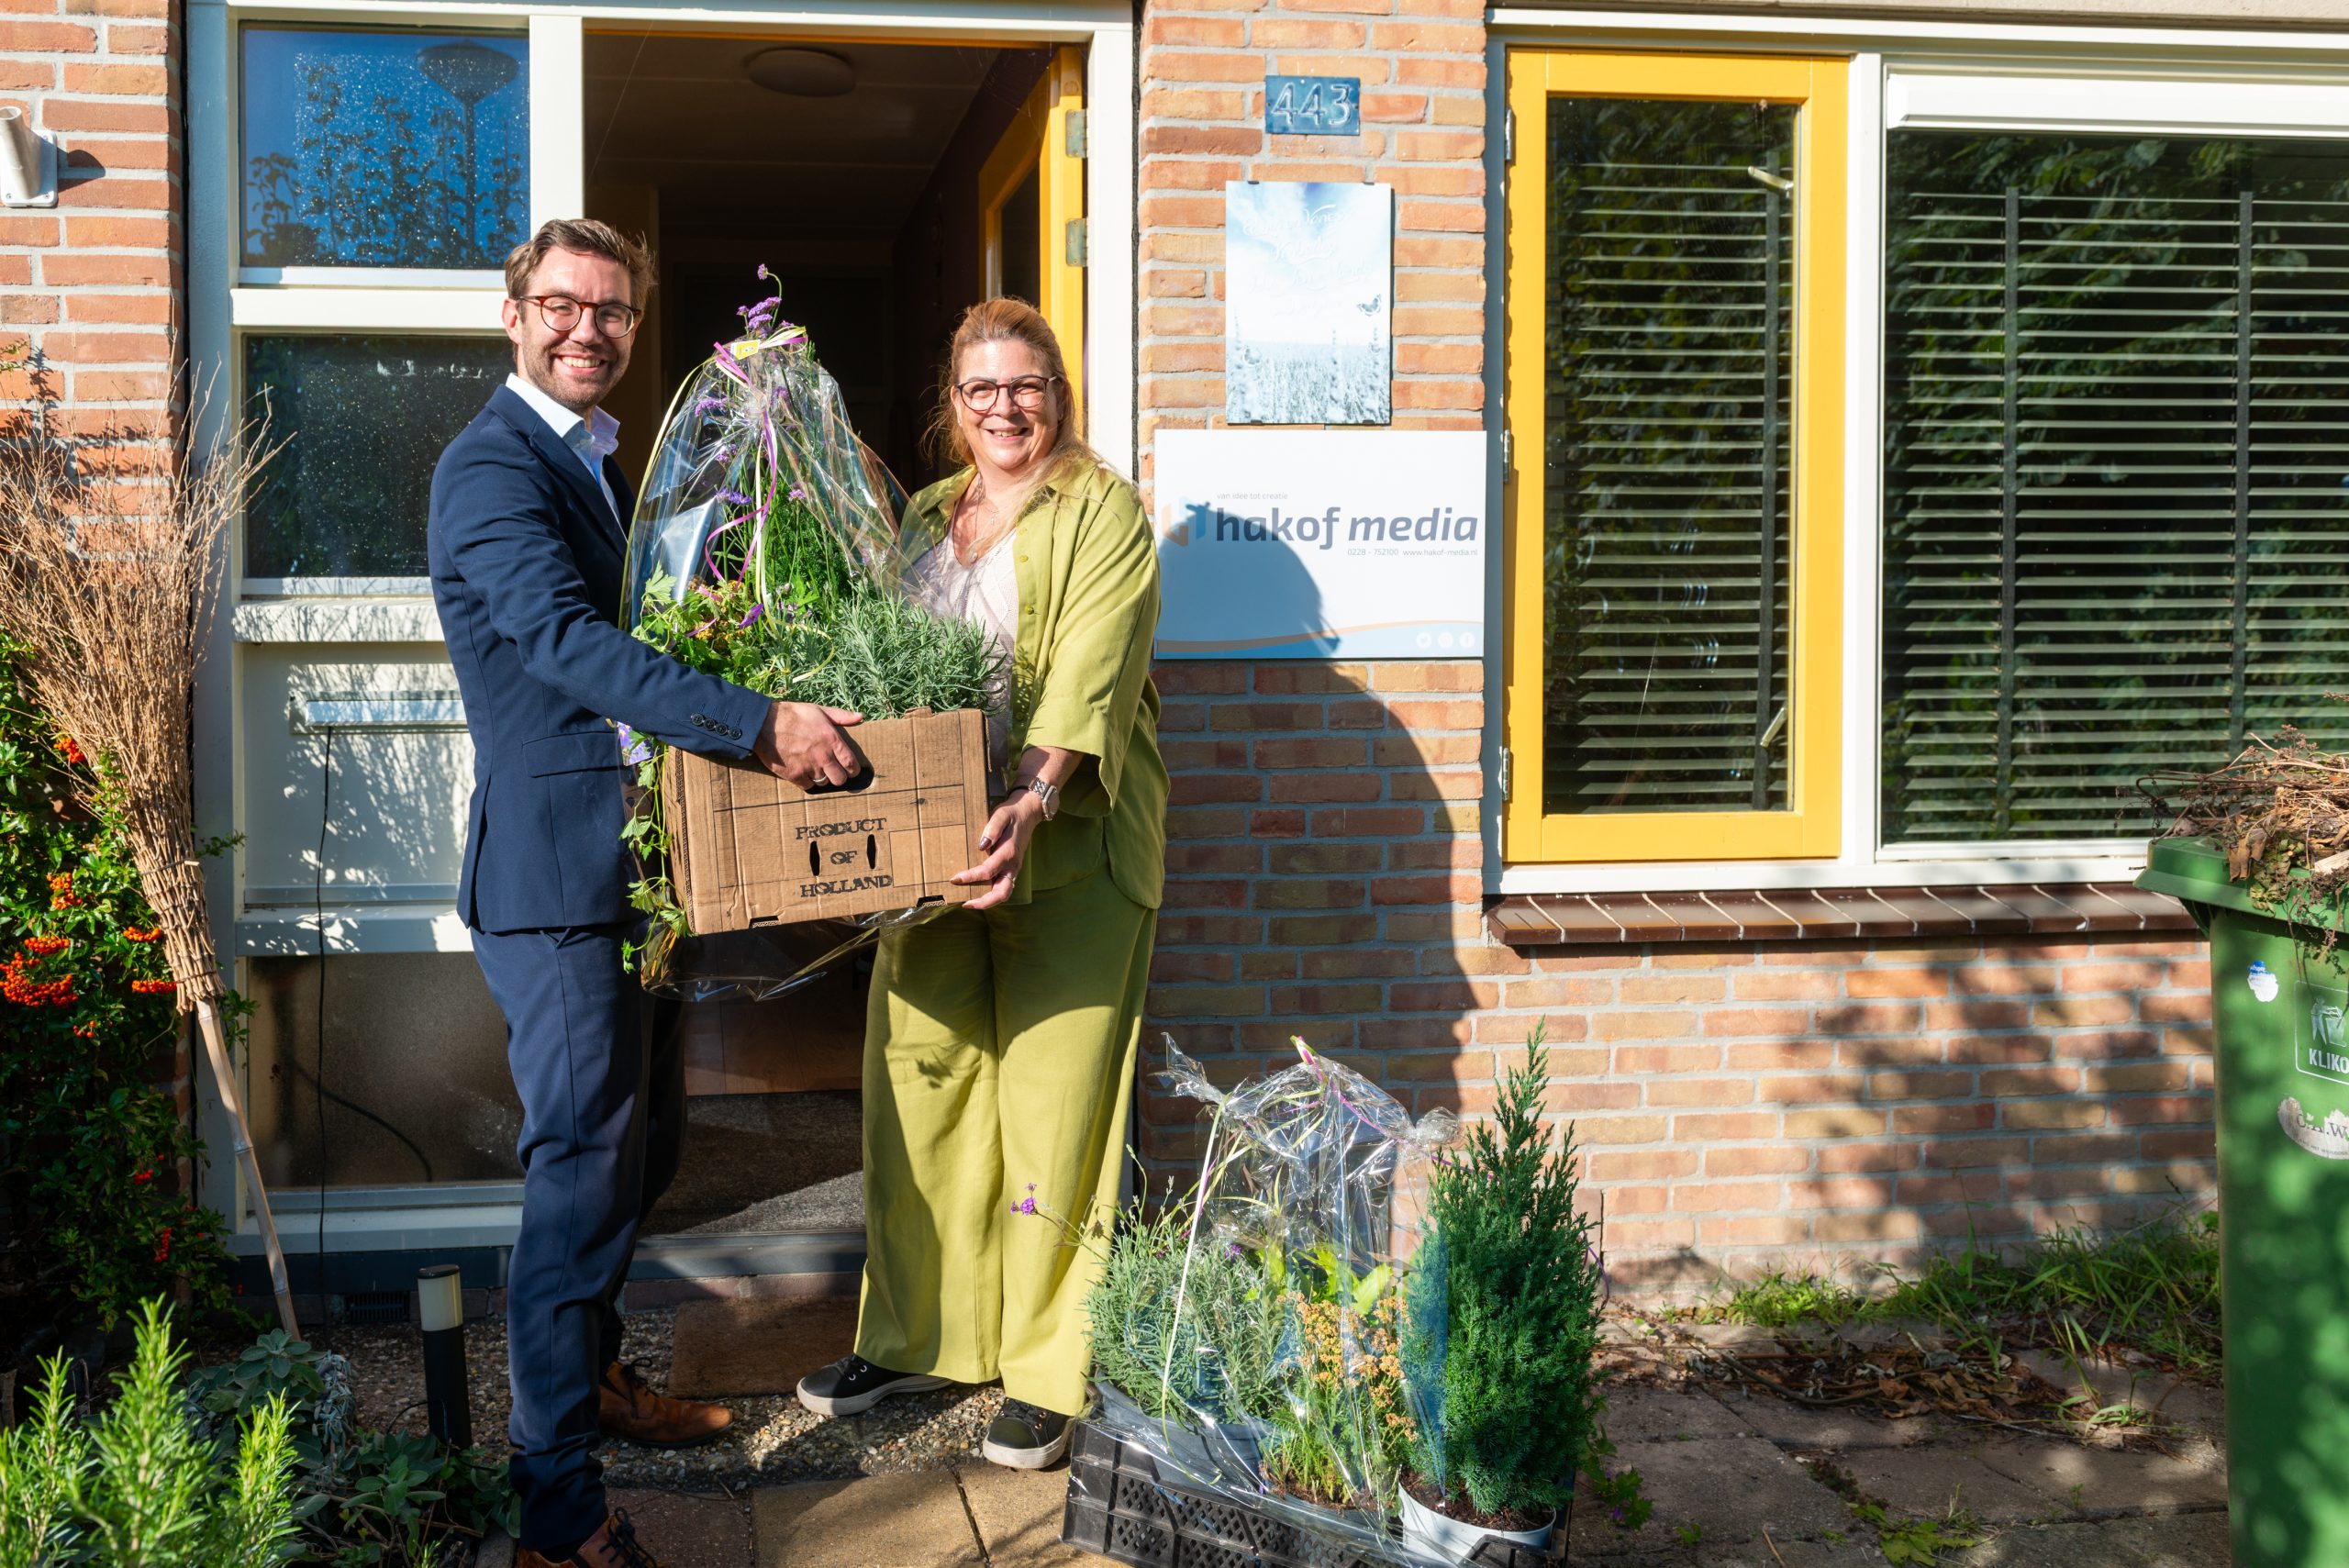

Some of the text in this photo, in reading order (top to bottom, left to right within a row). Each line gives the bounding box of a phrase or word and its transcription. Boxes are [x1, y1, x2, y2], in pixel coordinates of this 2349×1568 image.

[1270, 82, 1352, 126] 443
[1217, 492, 1288, 500] van idee tot creatie
[1216, 507, 1478, 550] hakof media
[796, 817, 887, 840] PRODUCT
[829, 851, 858, 865] OF
[800, 874, 893, 897] HOLLAND
[2309, 1048, 2349, 1074] KLIKO
